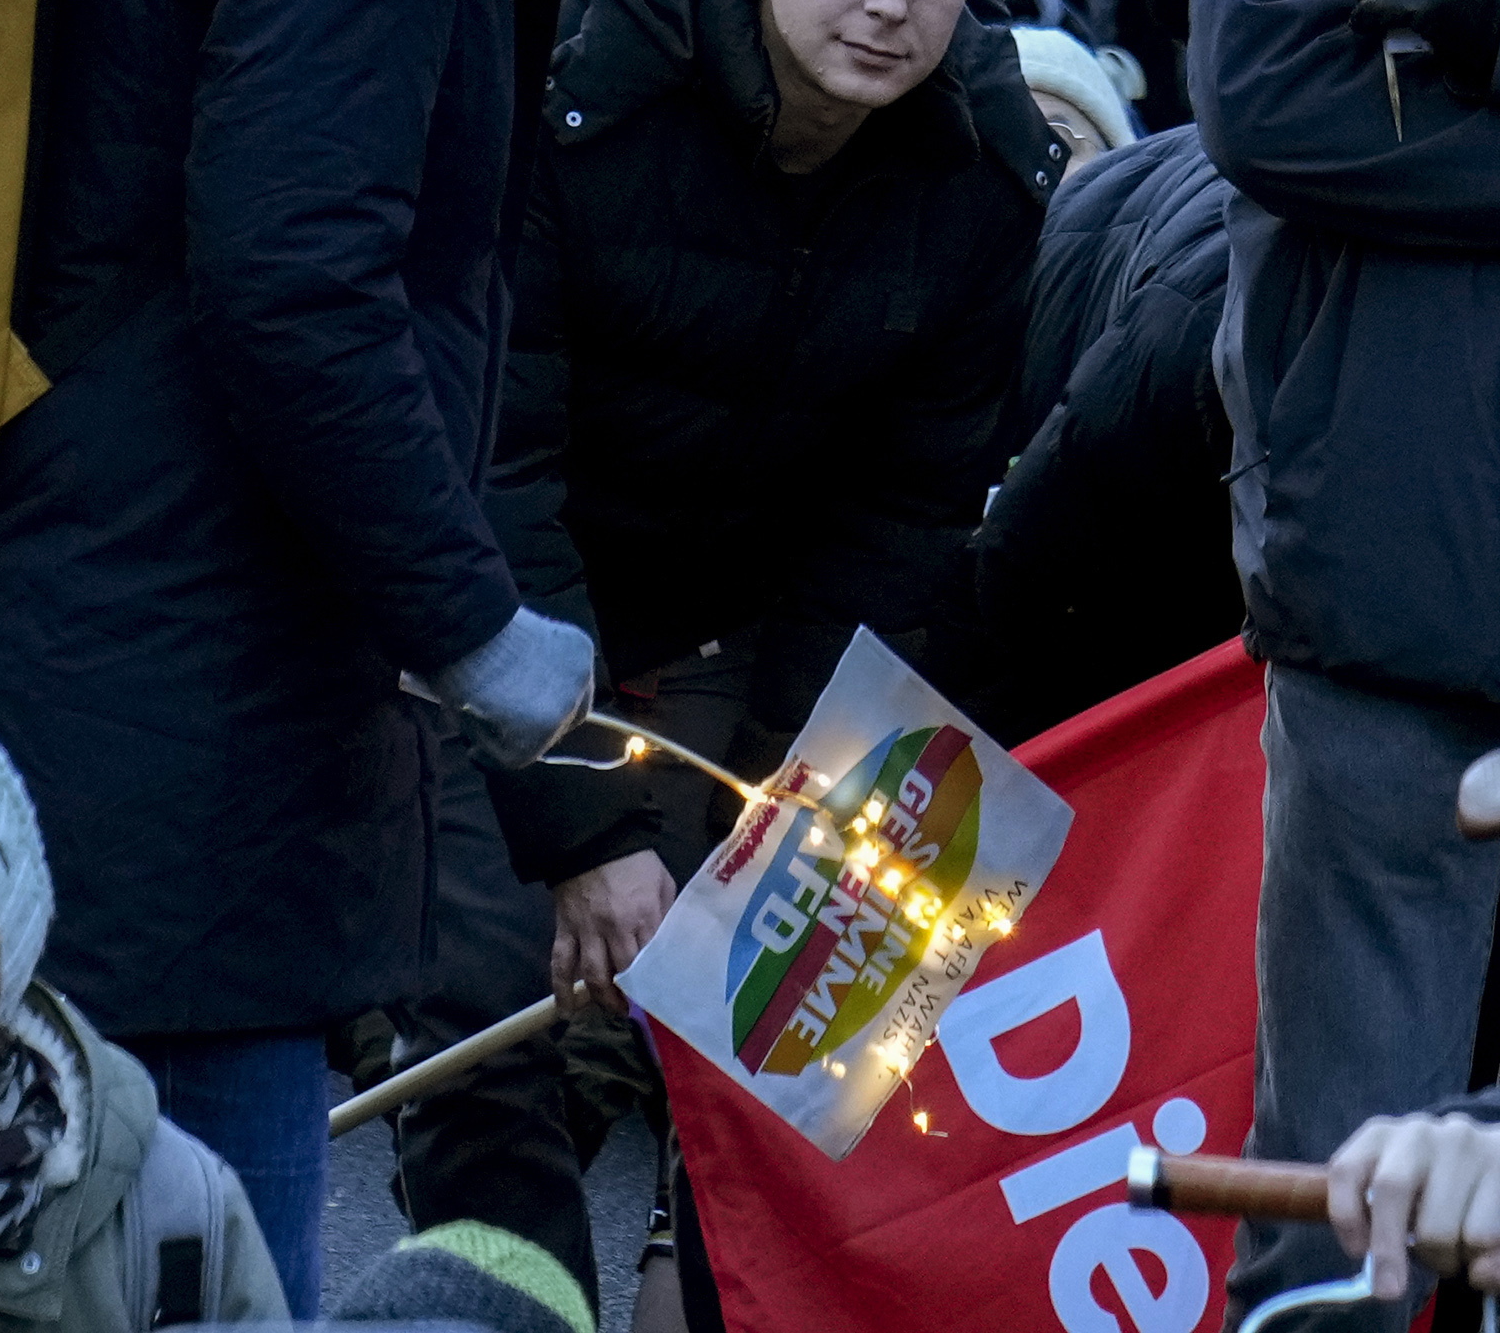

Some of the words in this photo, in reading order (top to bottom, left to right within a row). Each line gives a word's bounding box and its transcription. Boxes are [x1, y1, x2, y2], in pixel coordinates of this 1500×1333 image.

[747, 811, 845, 958] AFD
[786, 828, 942, 1049] SIMME
[944, 934, 974, 982] AFD
[883, 976, 929, 1041] NAZIS
[936, 927, 1210, 1333] Die
